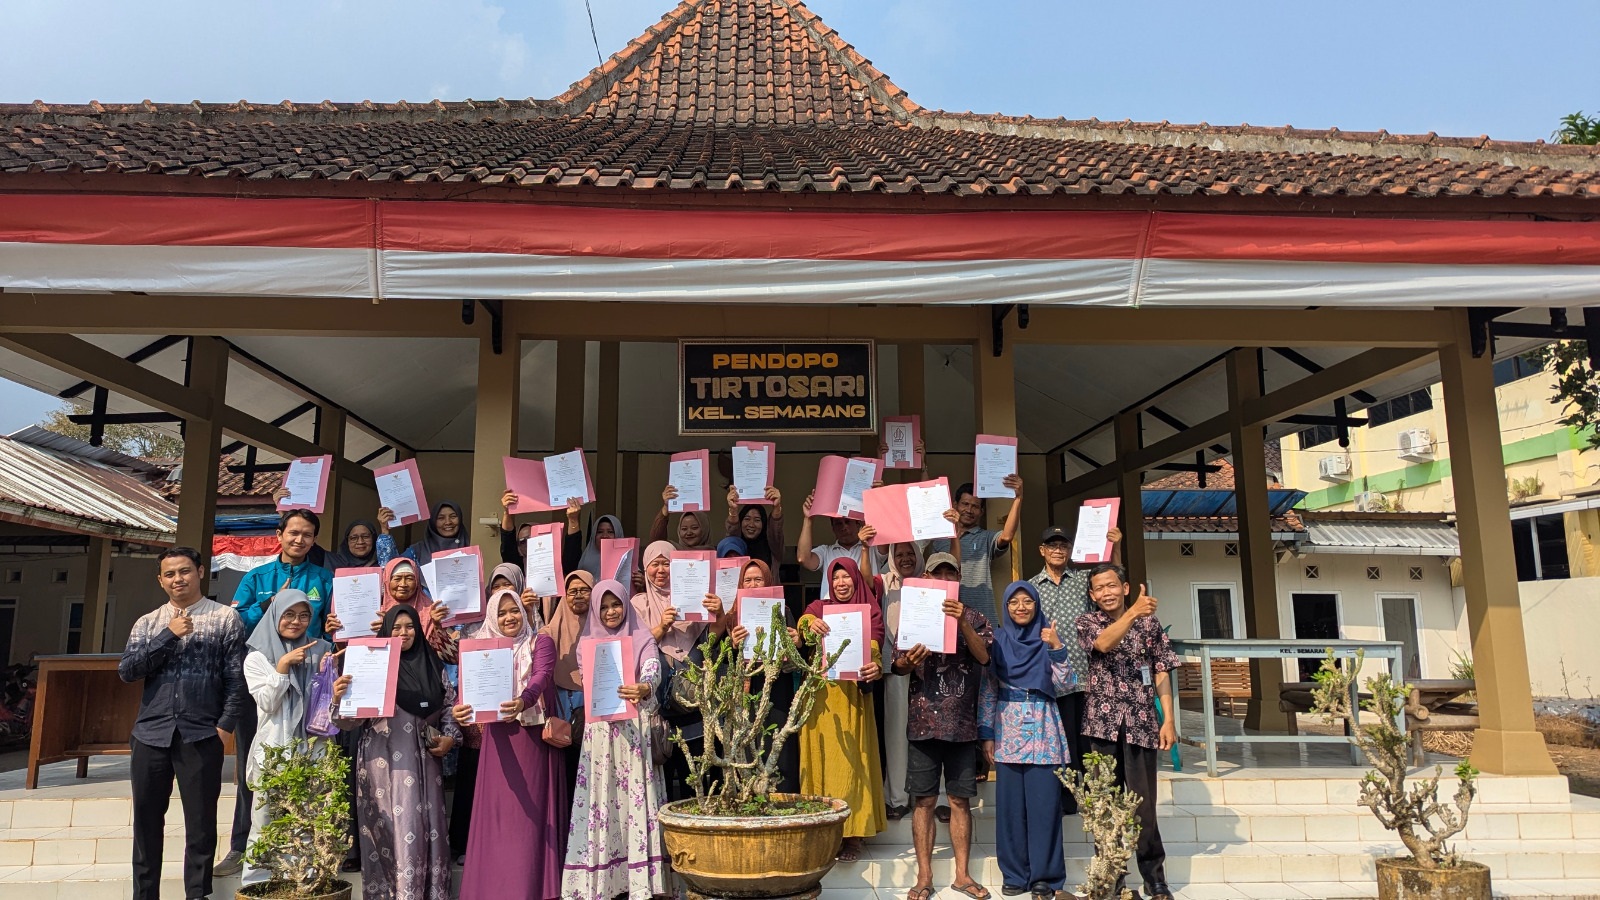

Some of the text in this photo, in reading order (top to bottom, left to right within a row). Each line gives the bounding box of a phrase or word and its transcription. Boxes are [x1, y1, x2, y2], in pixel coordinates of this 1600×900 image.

[713, 353, 838, 369] PENDOPO
[690, 375, 864, 399] TIRTOSARI
[688, 404, 866, 420] KEL. SEMARANG
